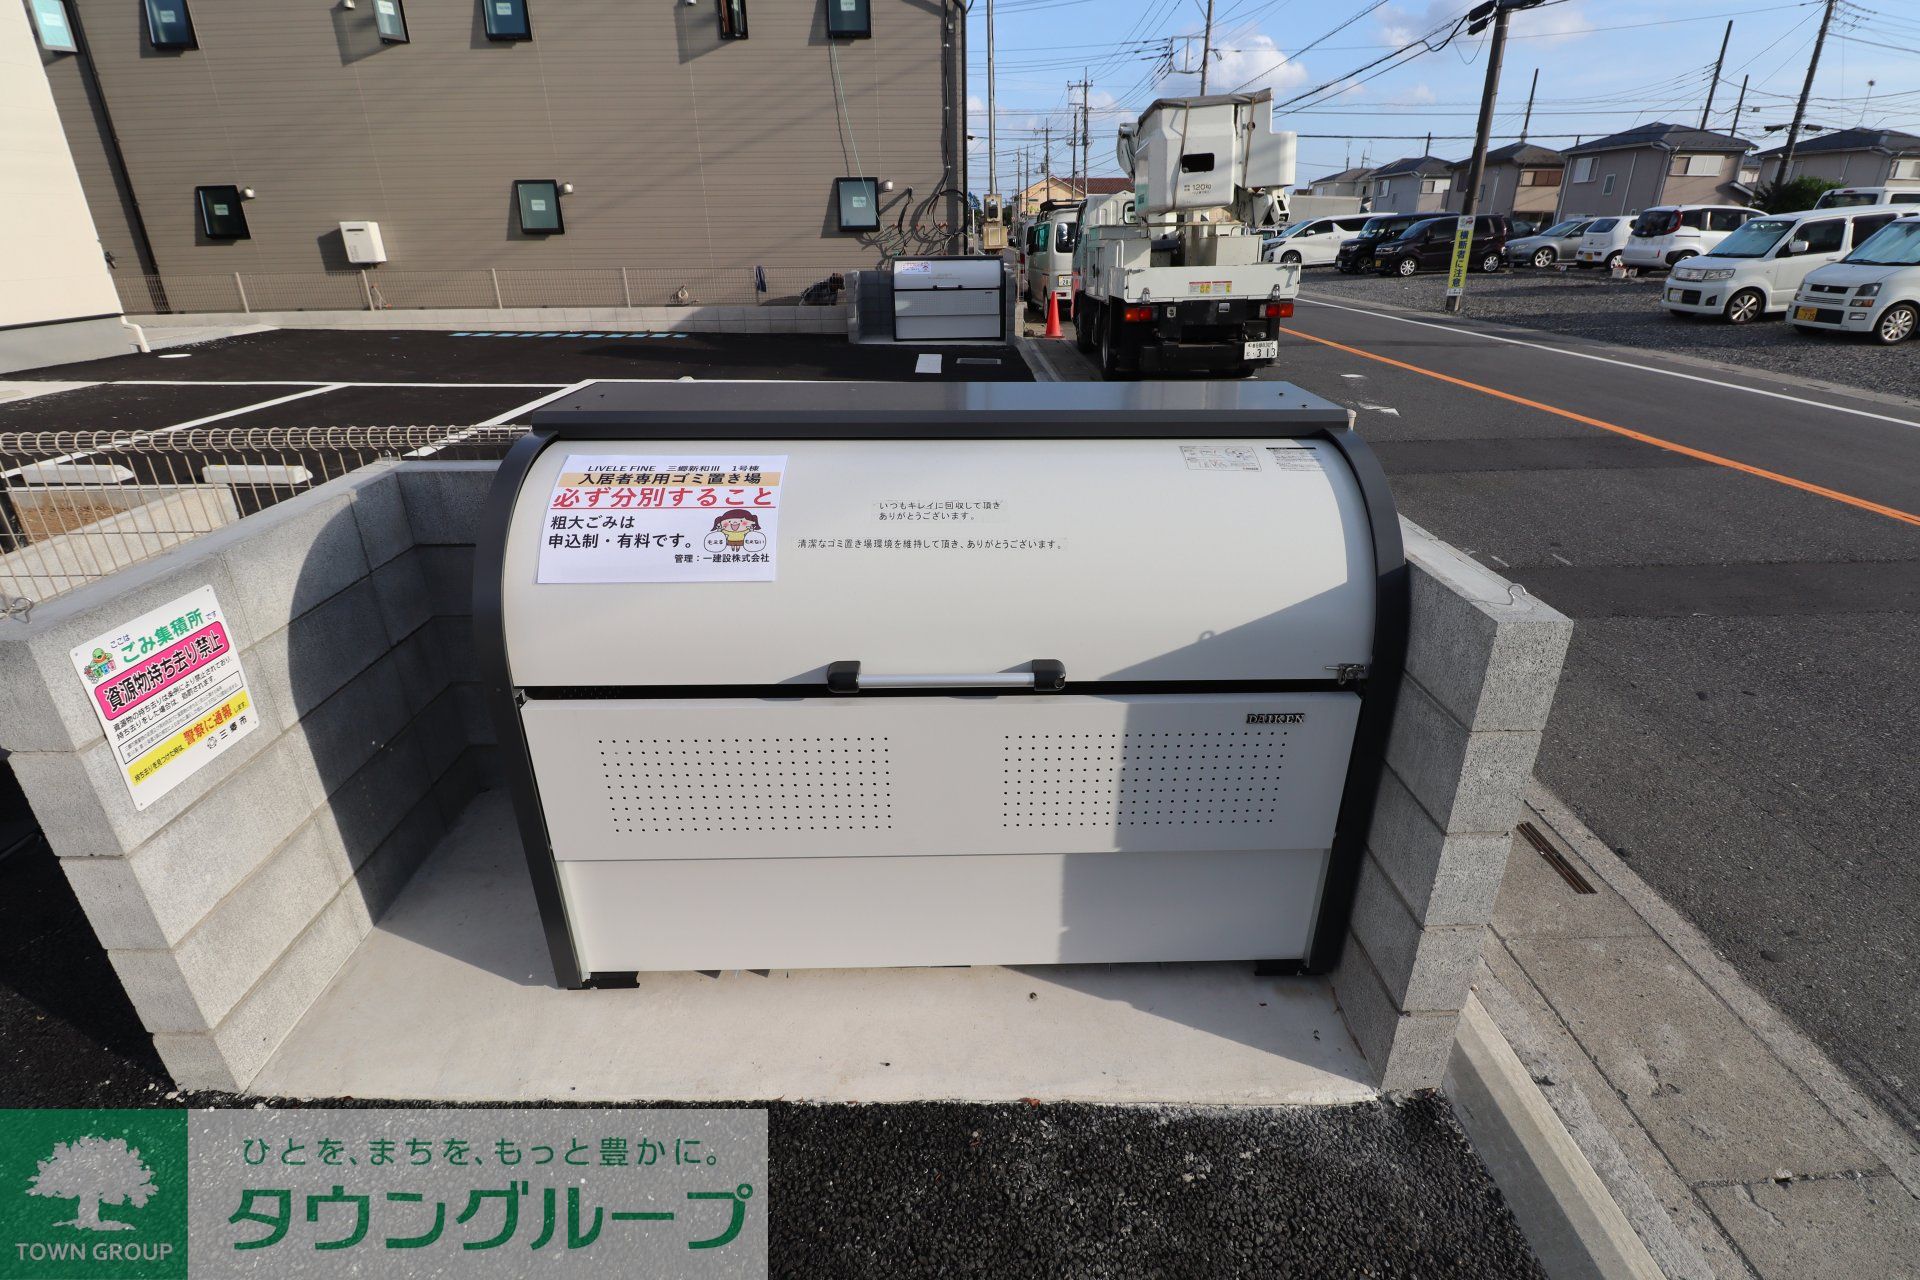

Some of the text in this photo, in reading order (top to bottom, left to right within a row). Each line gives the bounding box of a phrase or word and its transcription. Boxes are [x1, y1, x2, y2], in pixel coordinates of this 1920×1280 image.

[578, 472, 762, 485] 入居者専用ゴミ置き場
[553, 486, 772, 508] 必ず分別すること
[879, 500, 1001, 510] いつもキレイに回収して頂き
[550, 514, 635, 530] 粗大ごみは
[879, 511, 976, 521] ありがとうございます。
[549, 532, 692, 549] 申込制・有料です。
[110, 634, 131, 649] ここは
[121, 608, 217, 664] ごみ集積所 です
[104, 631, 224, 712] 資源物持ち去り禁止
[183, 704, 232, 745] 警察に通報
[1246, 713, 1305, 724] DAIKEN
